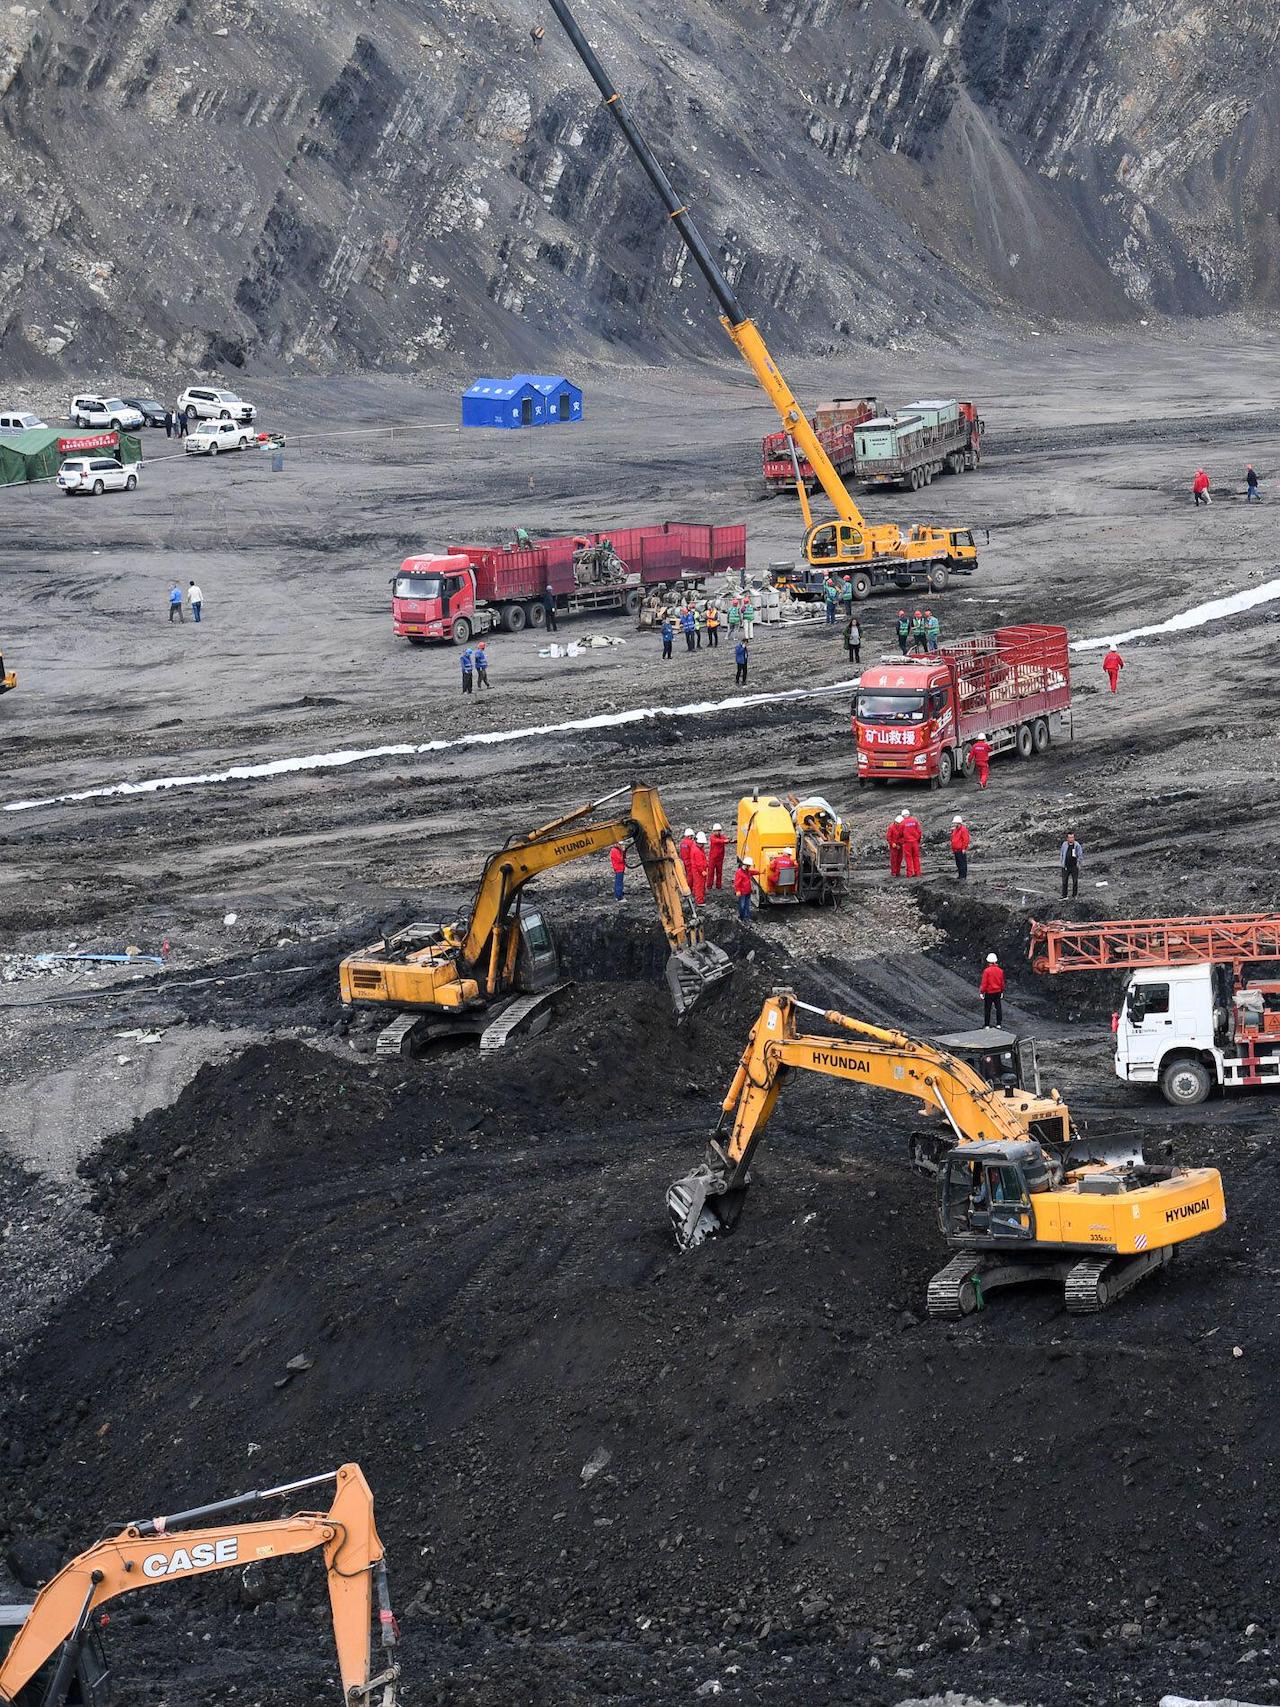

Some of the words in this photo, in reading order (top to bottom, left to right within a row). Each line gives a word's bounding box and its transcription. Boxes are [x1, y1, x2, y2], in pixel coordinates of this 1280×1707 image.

[865, 729, 916, 745] 矿山救援
[553, 837, 594, 856] HYUNDAI
[812, 1051, 870, 1073] HYUNDAI
[1165, 1198, 1210, 1223] HYUNDAI
[142, 1536, 238, 1578] CASE
